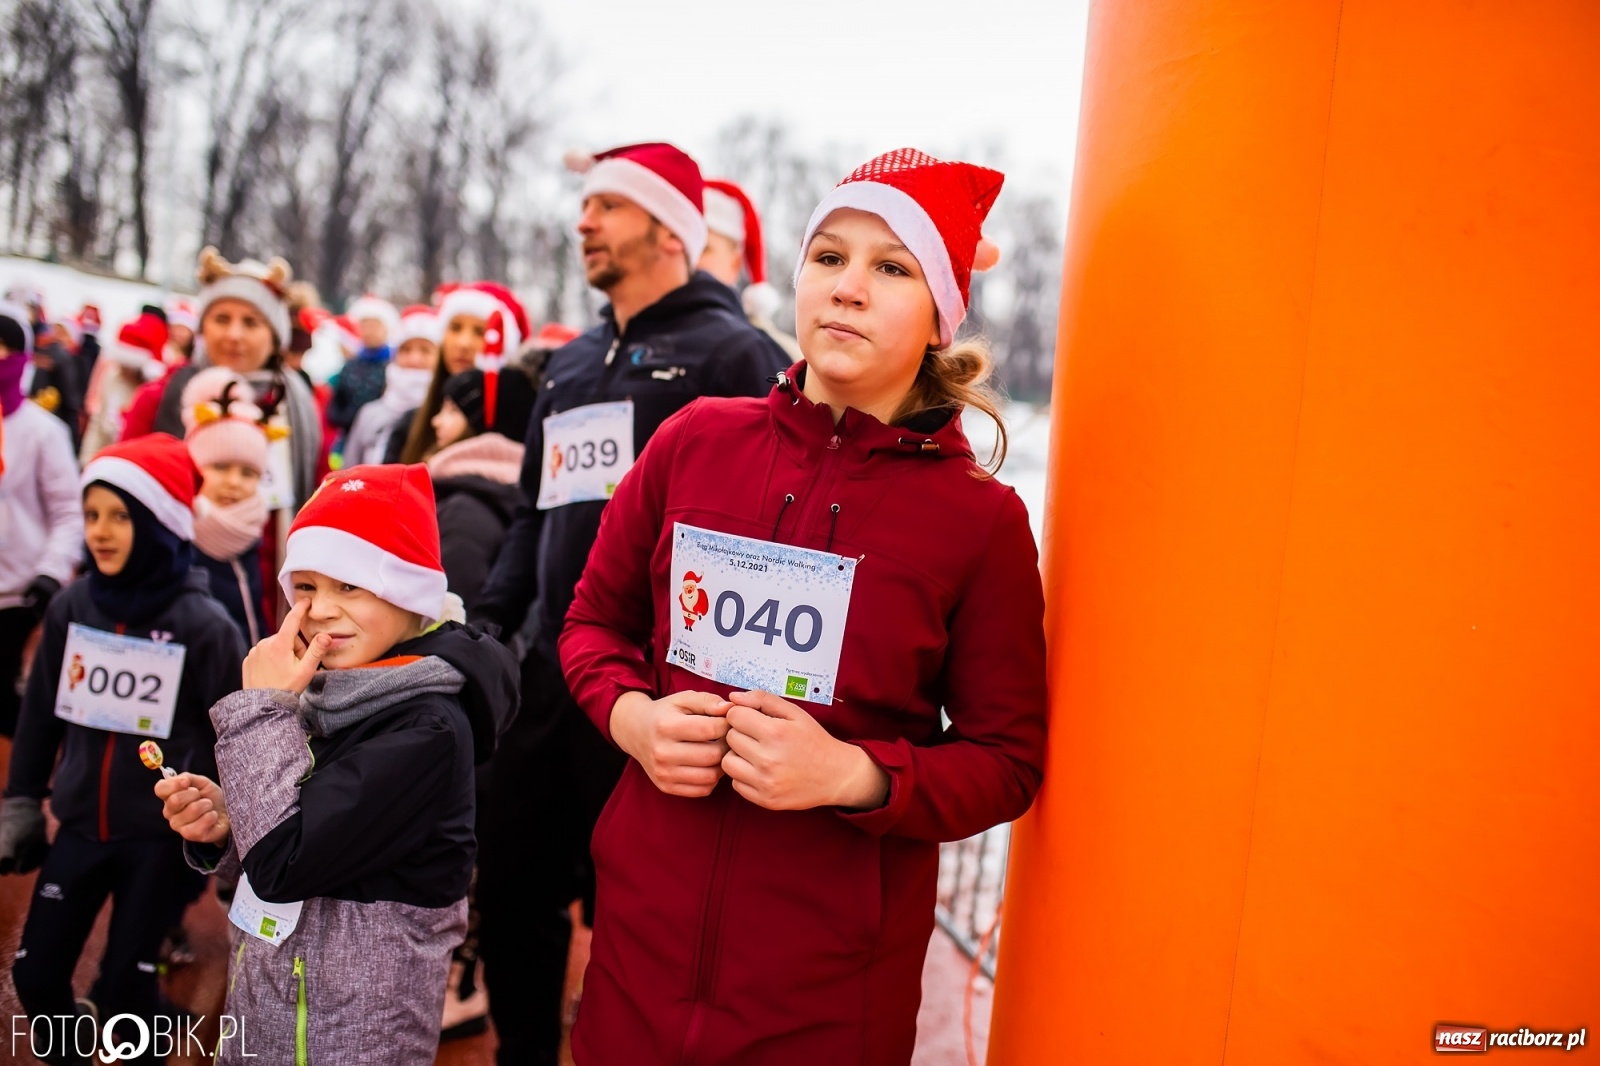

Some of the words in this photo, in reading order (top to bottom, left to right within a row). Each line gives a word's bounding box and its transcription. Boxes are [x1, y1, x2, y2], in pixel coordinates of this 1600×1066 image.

[566, 438, 618, 472] 039
[729, 558, 769, 573] 5.12.2021
[745, 553, 761, 561] oraz
[761, 555, 786, 566] Nordic
[787, 558, 817, 572] Walking
[713, 590, 823, 653] 040
[88, 666, 162, 704] 002
